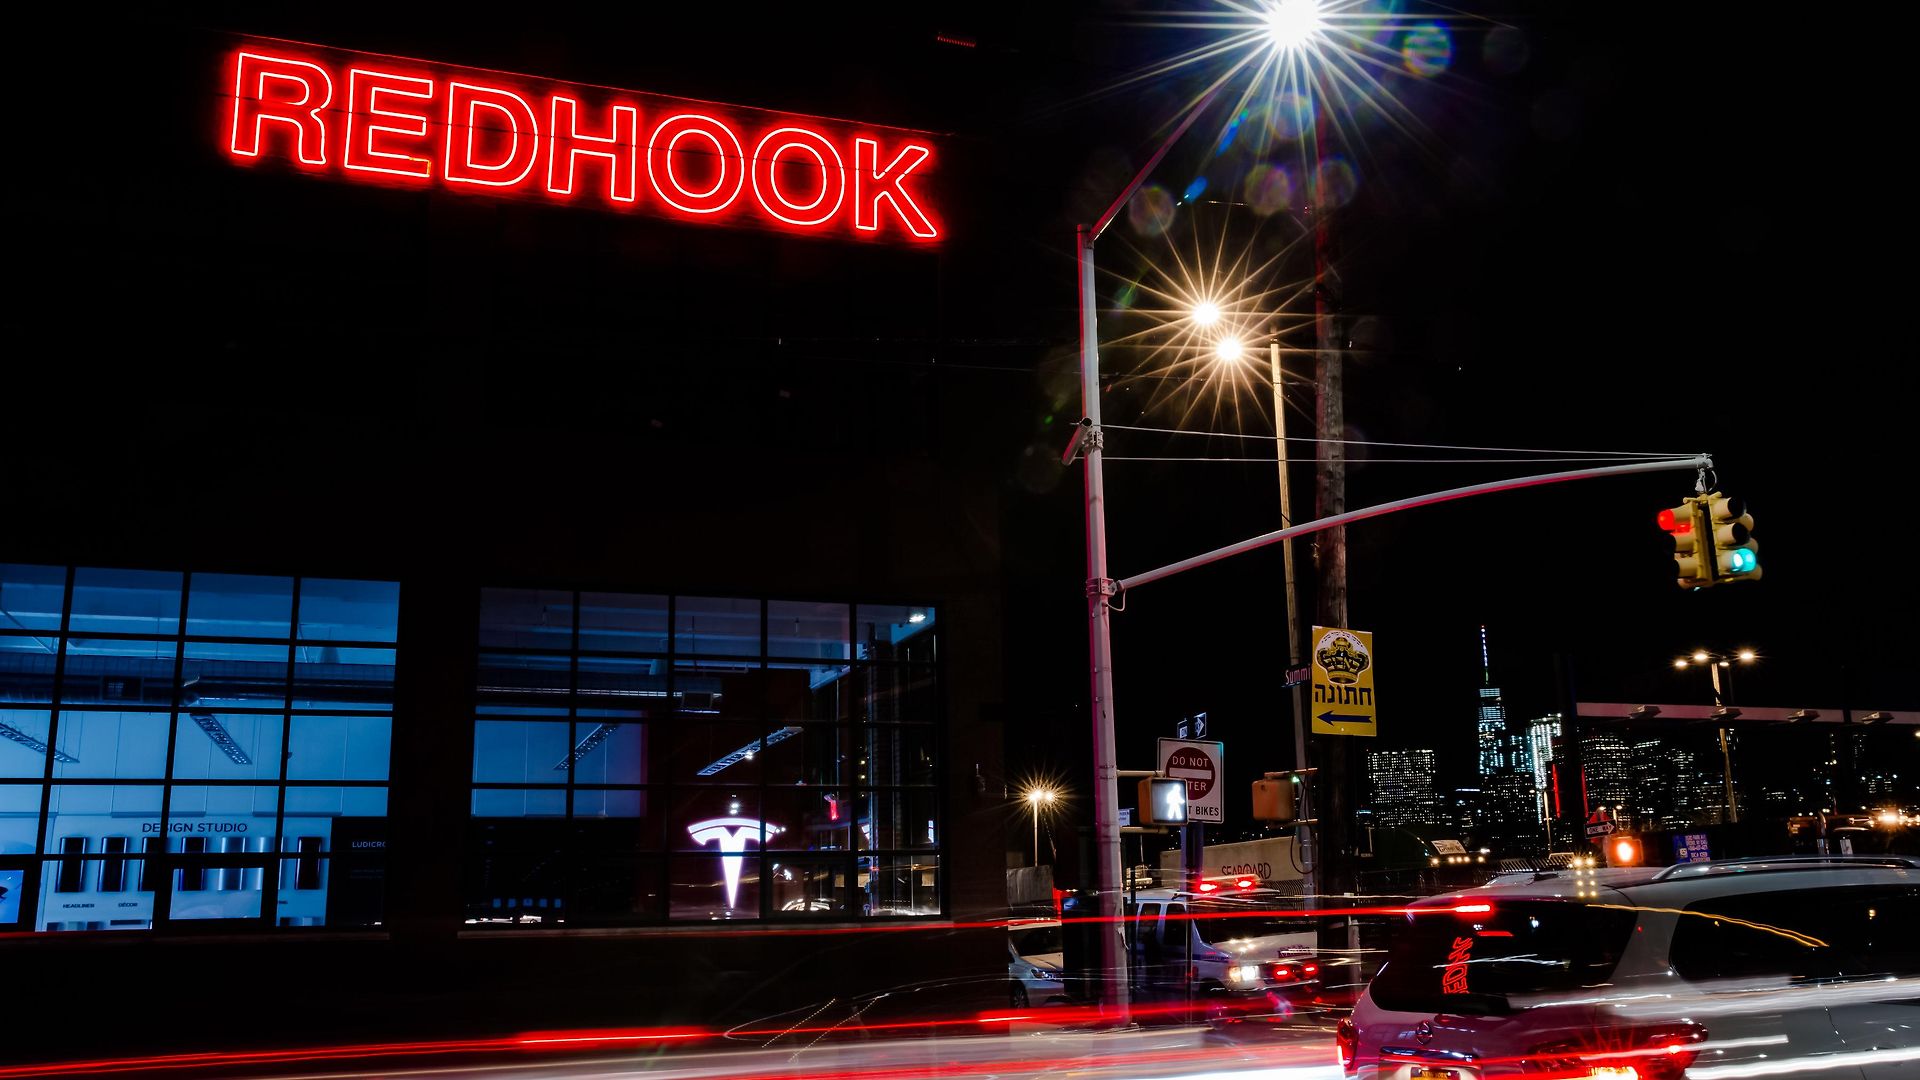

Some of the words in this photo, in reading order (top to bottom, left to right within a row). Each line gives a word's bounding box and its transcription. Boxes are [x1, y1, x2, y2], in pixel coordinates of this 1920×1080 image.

[229, 51, 939, 239] REDHOOK
[1285, 662, 1311, 685] Summi
[1315, 684, 1372, 706] חתונה
[1172, 756, 1186, 766] DO
[1189, 757, 1209, 768] NOT
[1187, 780, 1207, 791] TER
[1195, 806, 1220, 817] BIKES
[142, 822, 193, 833] DEIGN
[197, 823, 248, 833] STUDIO
